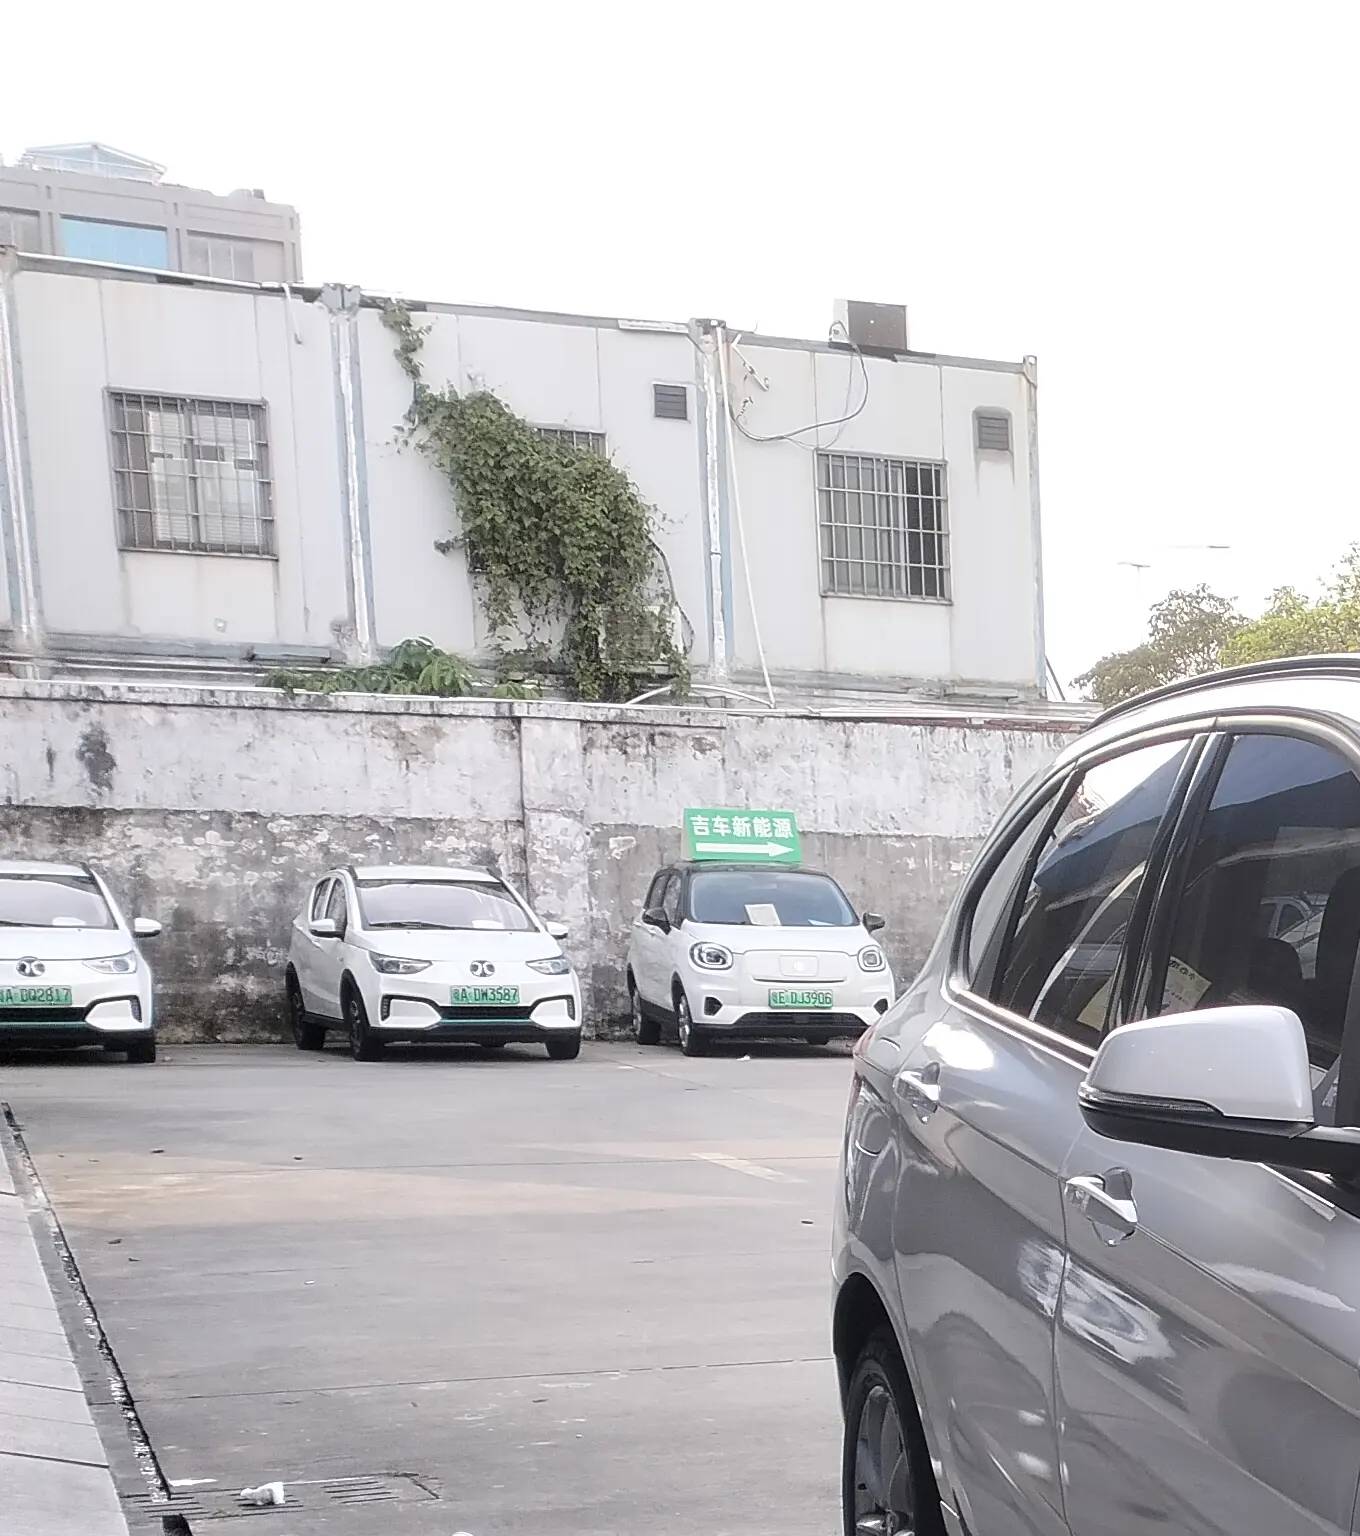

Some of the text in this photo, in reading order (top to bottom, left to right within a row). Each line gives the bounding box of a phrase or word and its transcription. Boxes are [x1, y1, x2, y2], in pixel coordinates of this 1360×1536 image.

[689, 814, 794, 839] 吉车新能源
